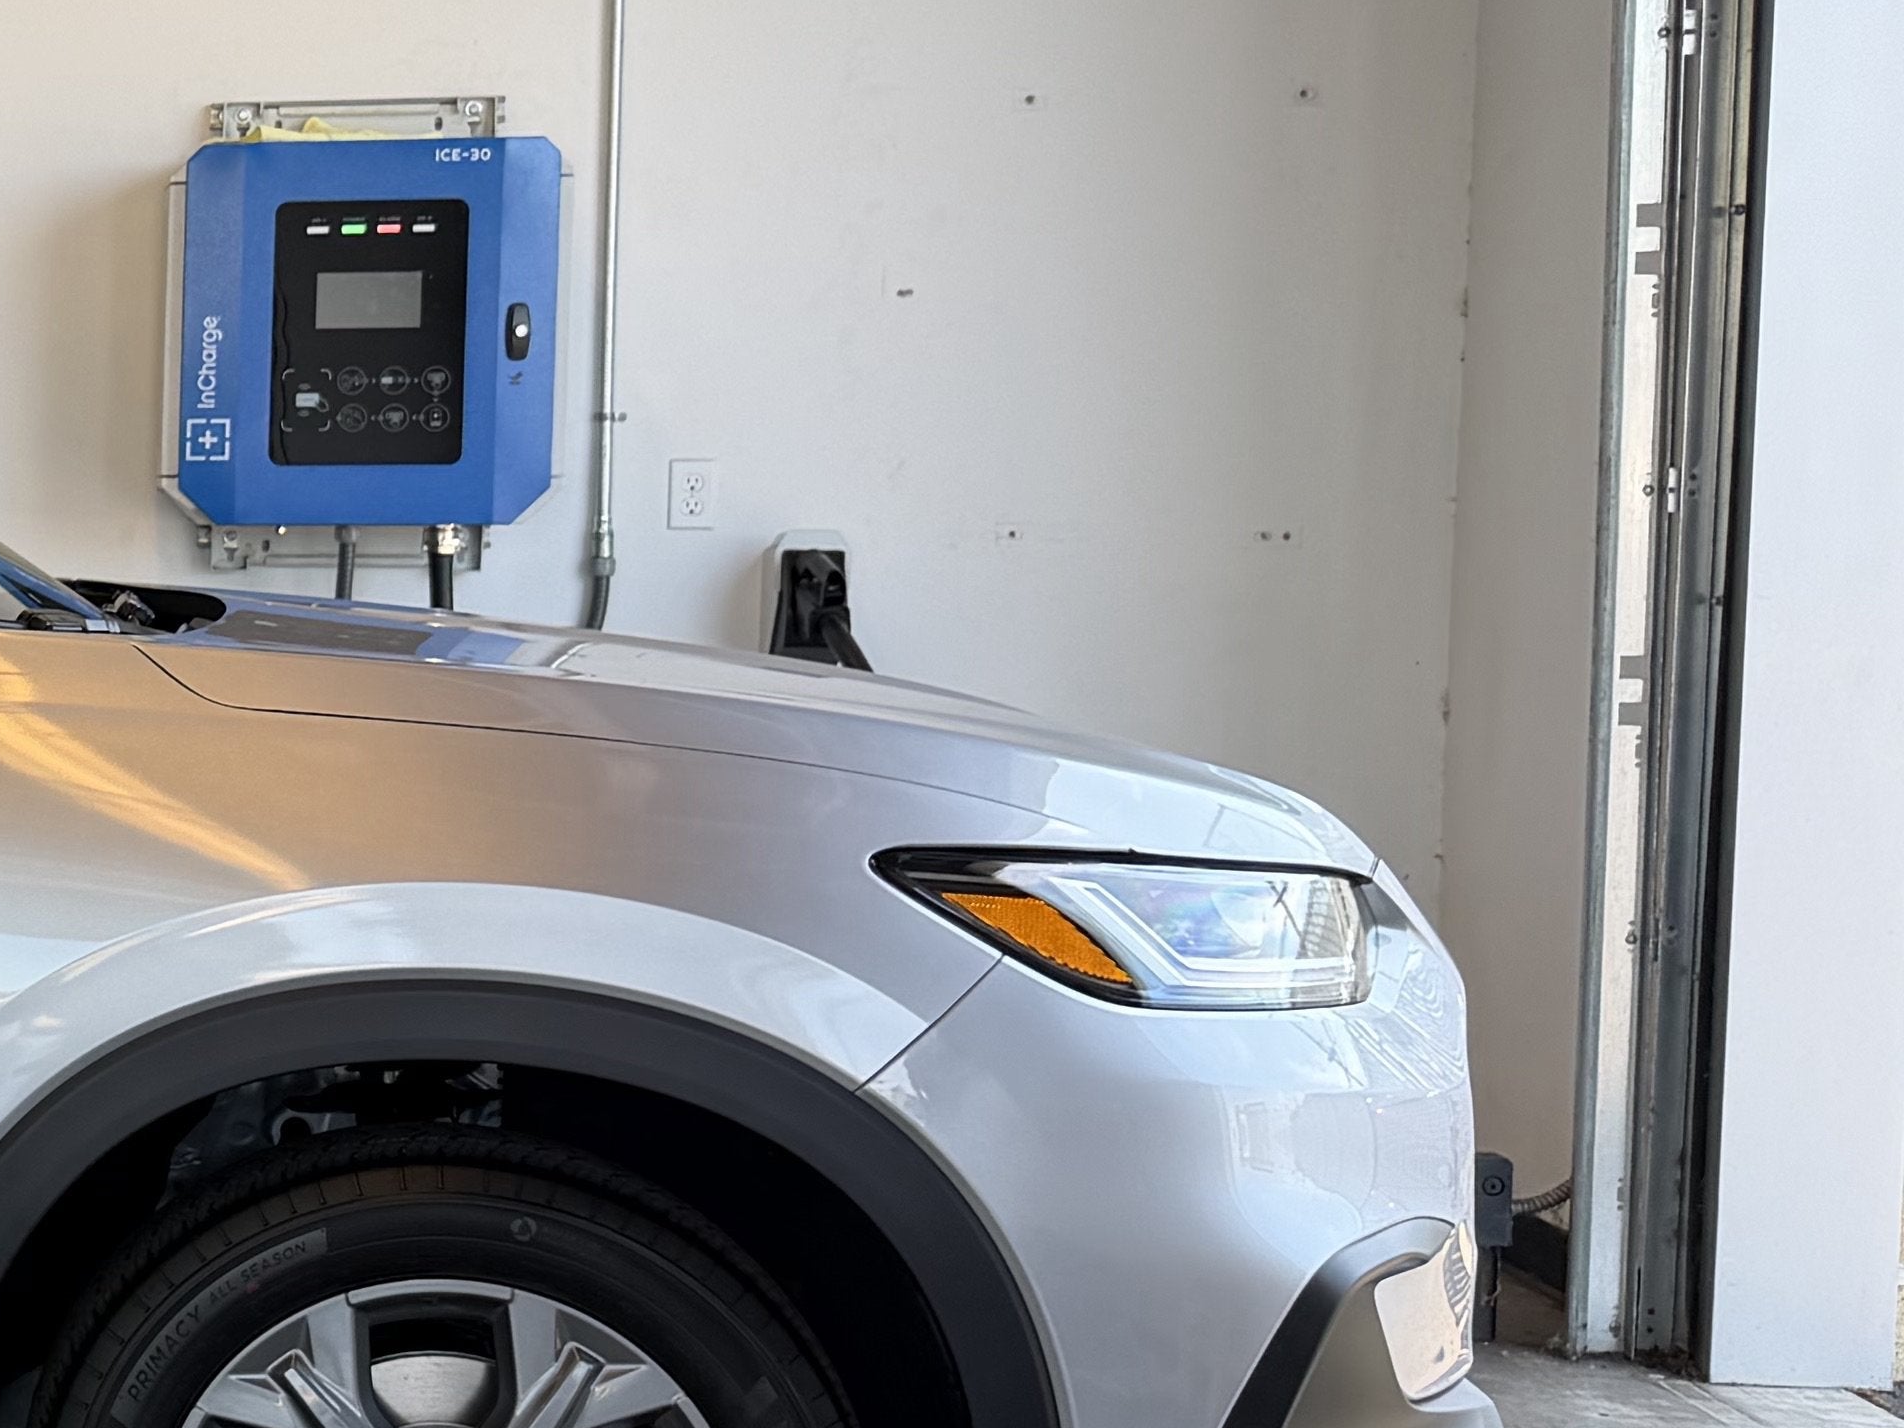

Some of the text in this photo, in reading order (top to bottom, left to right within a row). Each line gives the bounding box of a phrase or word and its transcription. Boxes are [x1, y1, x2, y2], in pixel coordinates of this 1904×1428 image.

[435, 148, 492, 162] ICE-30
[196, 316, 223, 409] InCharge
[127, 1240, 307, 1402] PRIMACY ALL SEASON
